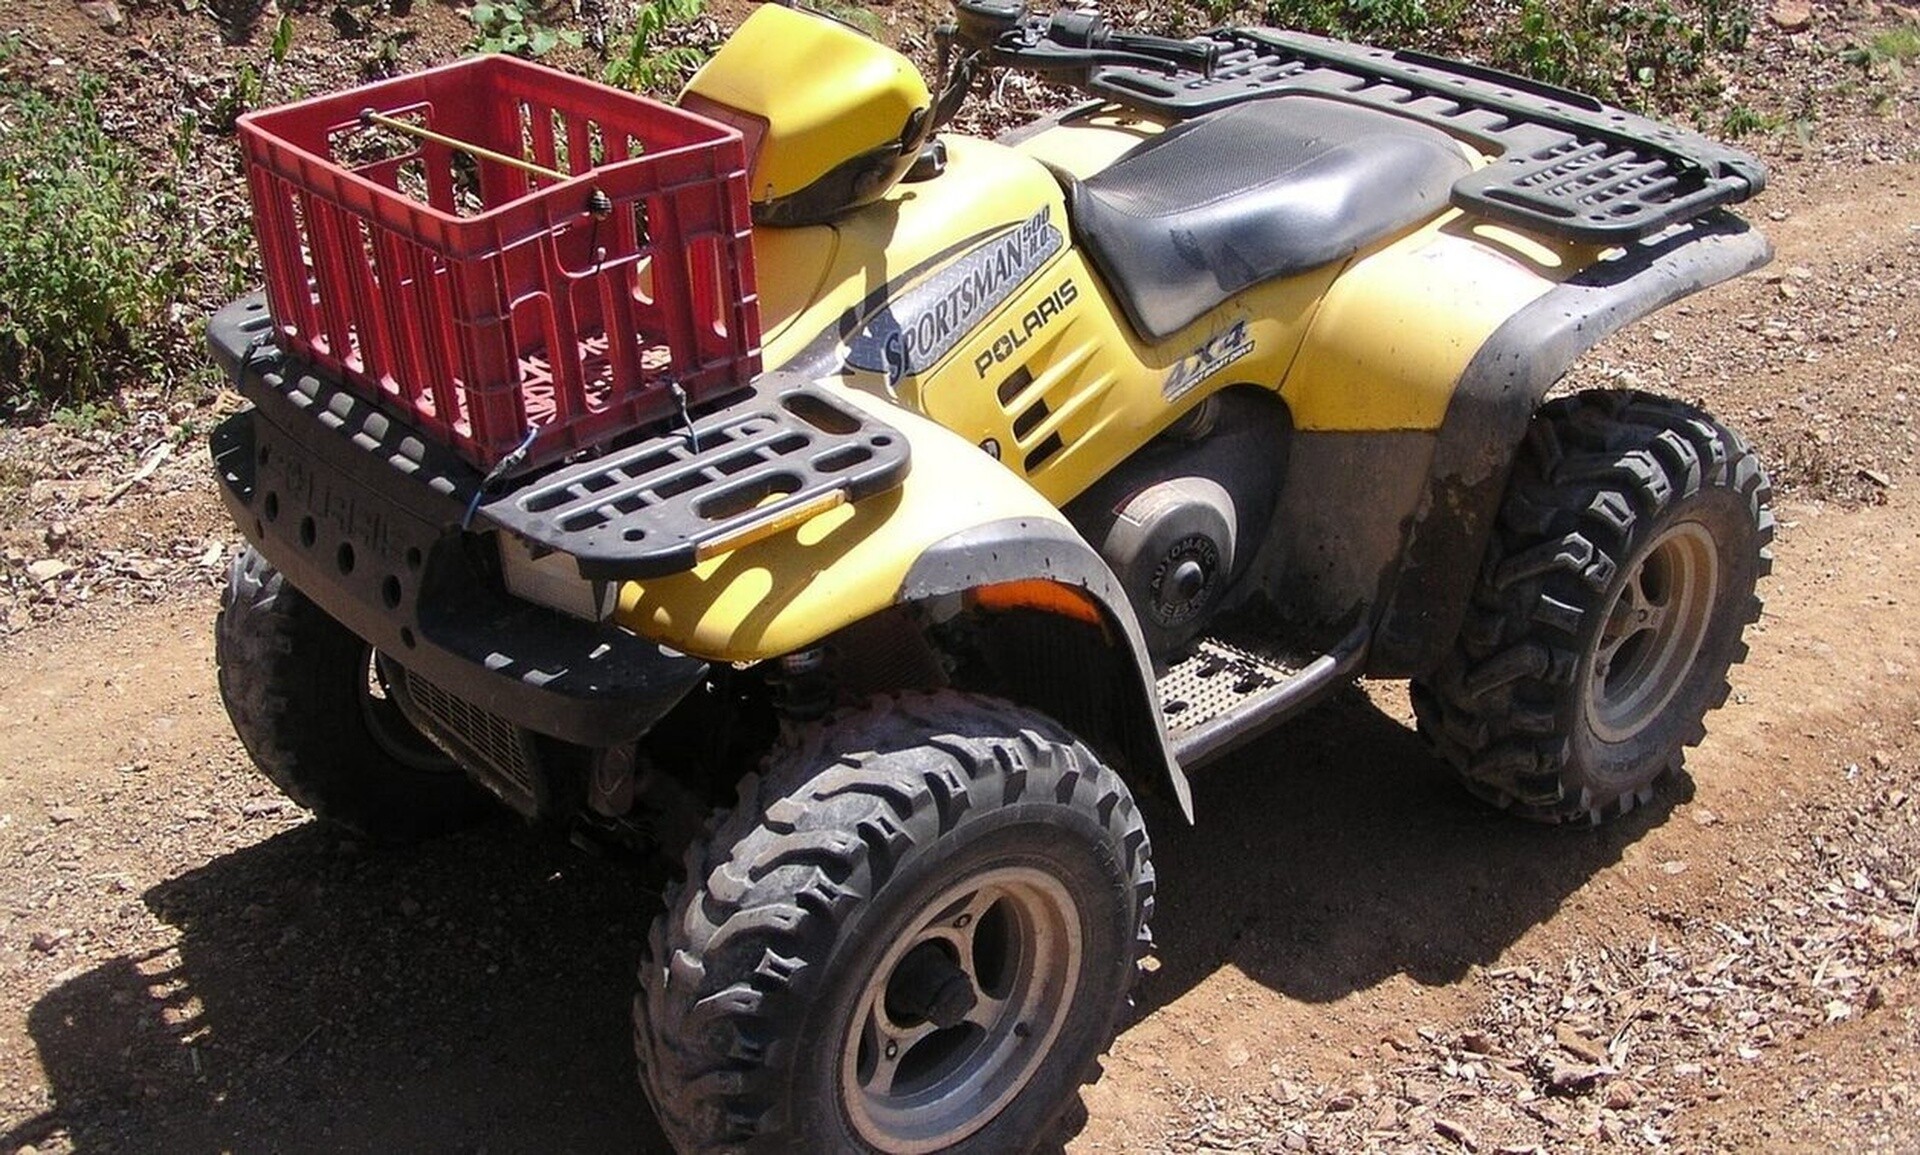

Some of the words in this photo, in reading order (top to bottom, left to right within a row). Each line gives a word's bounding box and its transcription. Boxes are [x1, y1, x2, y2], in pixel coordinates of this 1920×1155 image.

[884, 231, 1022, 386] SPORTSMAN
[1023, 204, 1050, 242] 500
[974, 278, 1079, 379] POLARIS
[1151, 538, 1214, 589] AUTOMATIC
